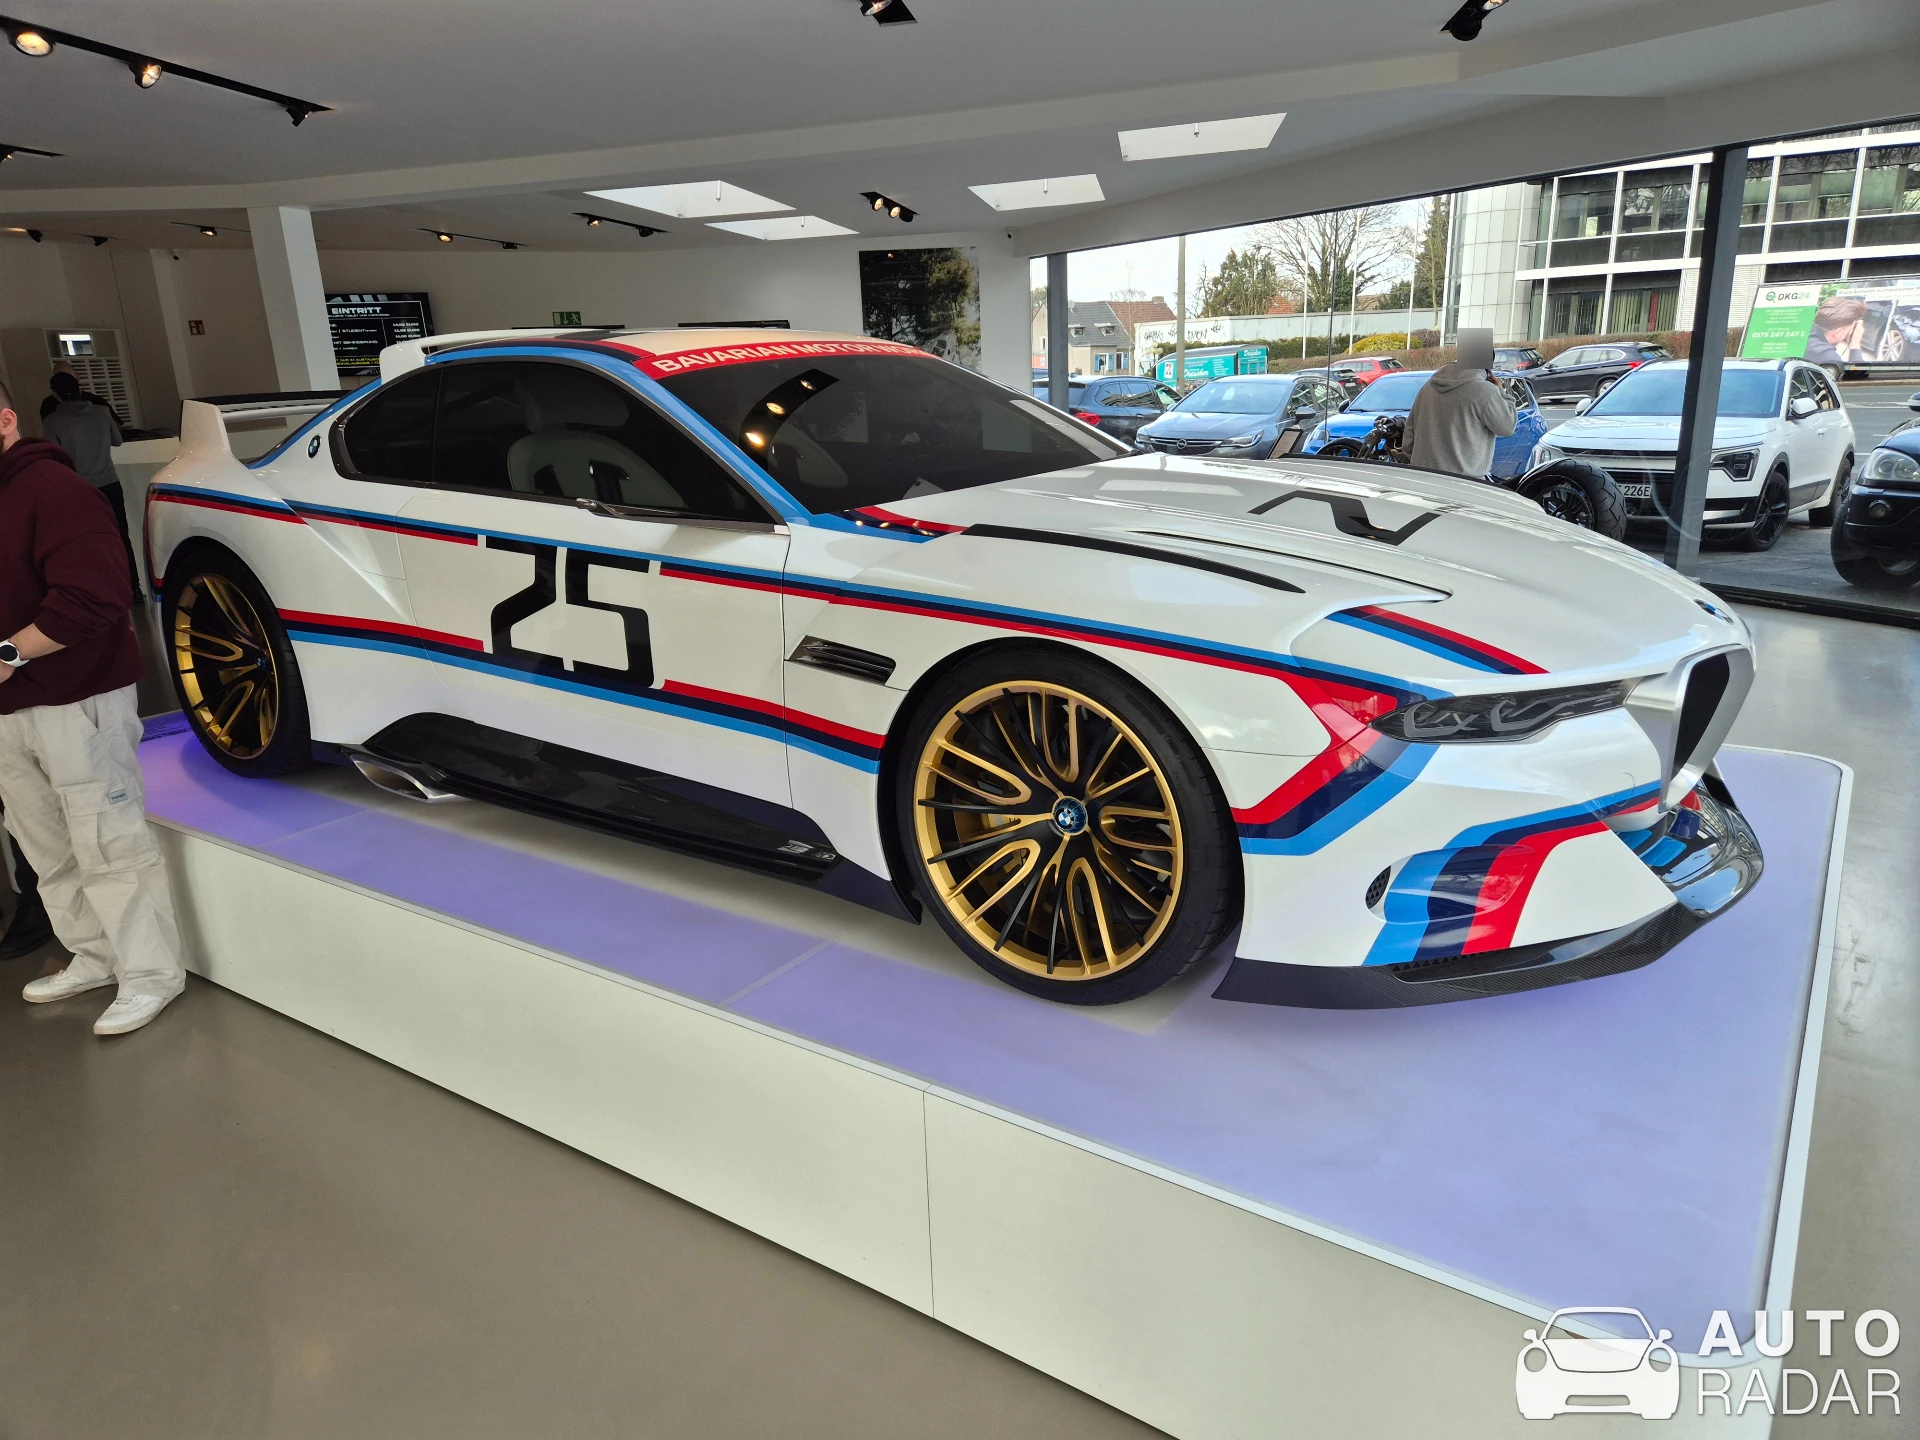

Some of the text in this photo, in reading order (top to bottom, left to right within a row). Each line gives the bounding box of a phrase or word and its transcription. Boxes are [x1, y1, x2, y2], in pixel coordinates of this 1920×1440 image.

[1778, 291, 1811, 301] DKG24
[652, 343, 798, 372] BAVARIAN
[790, 343, 882, 353] MOTOR
[486, 534, 655, 690] 25
